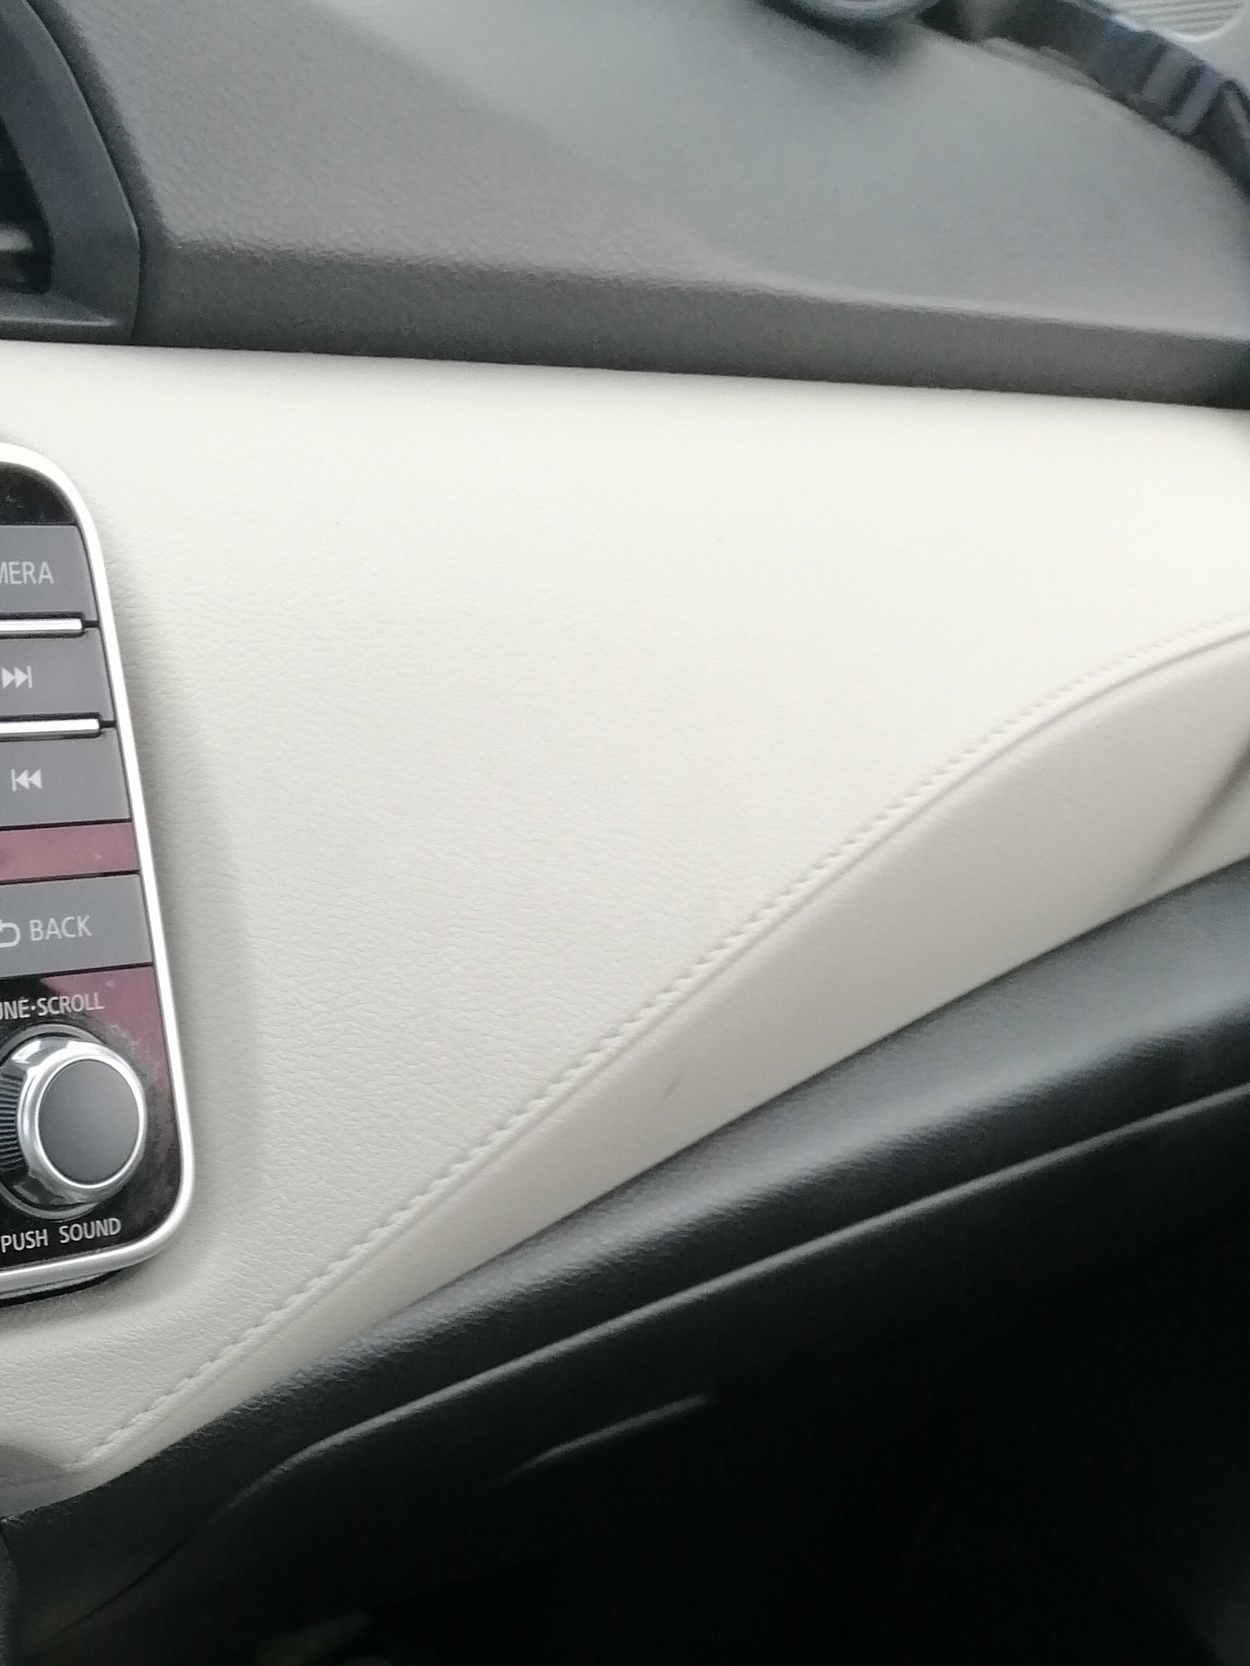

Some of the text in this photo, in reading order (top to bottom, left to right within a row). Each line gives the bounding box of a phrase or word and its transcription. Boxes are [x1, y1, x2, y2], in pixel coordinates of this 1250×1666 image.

[29, 915, 93, 941] BACK
[0, 1217, 122, 1253] PUSH SOUND
